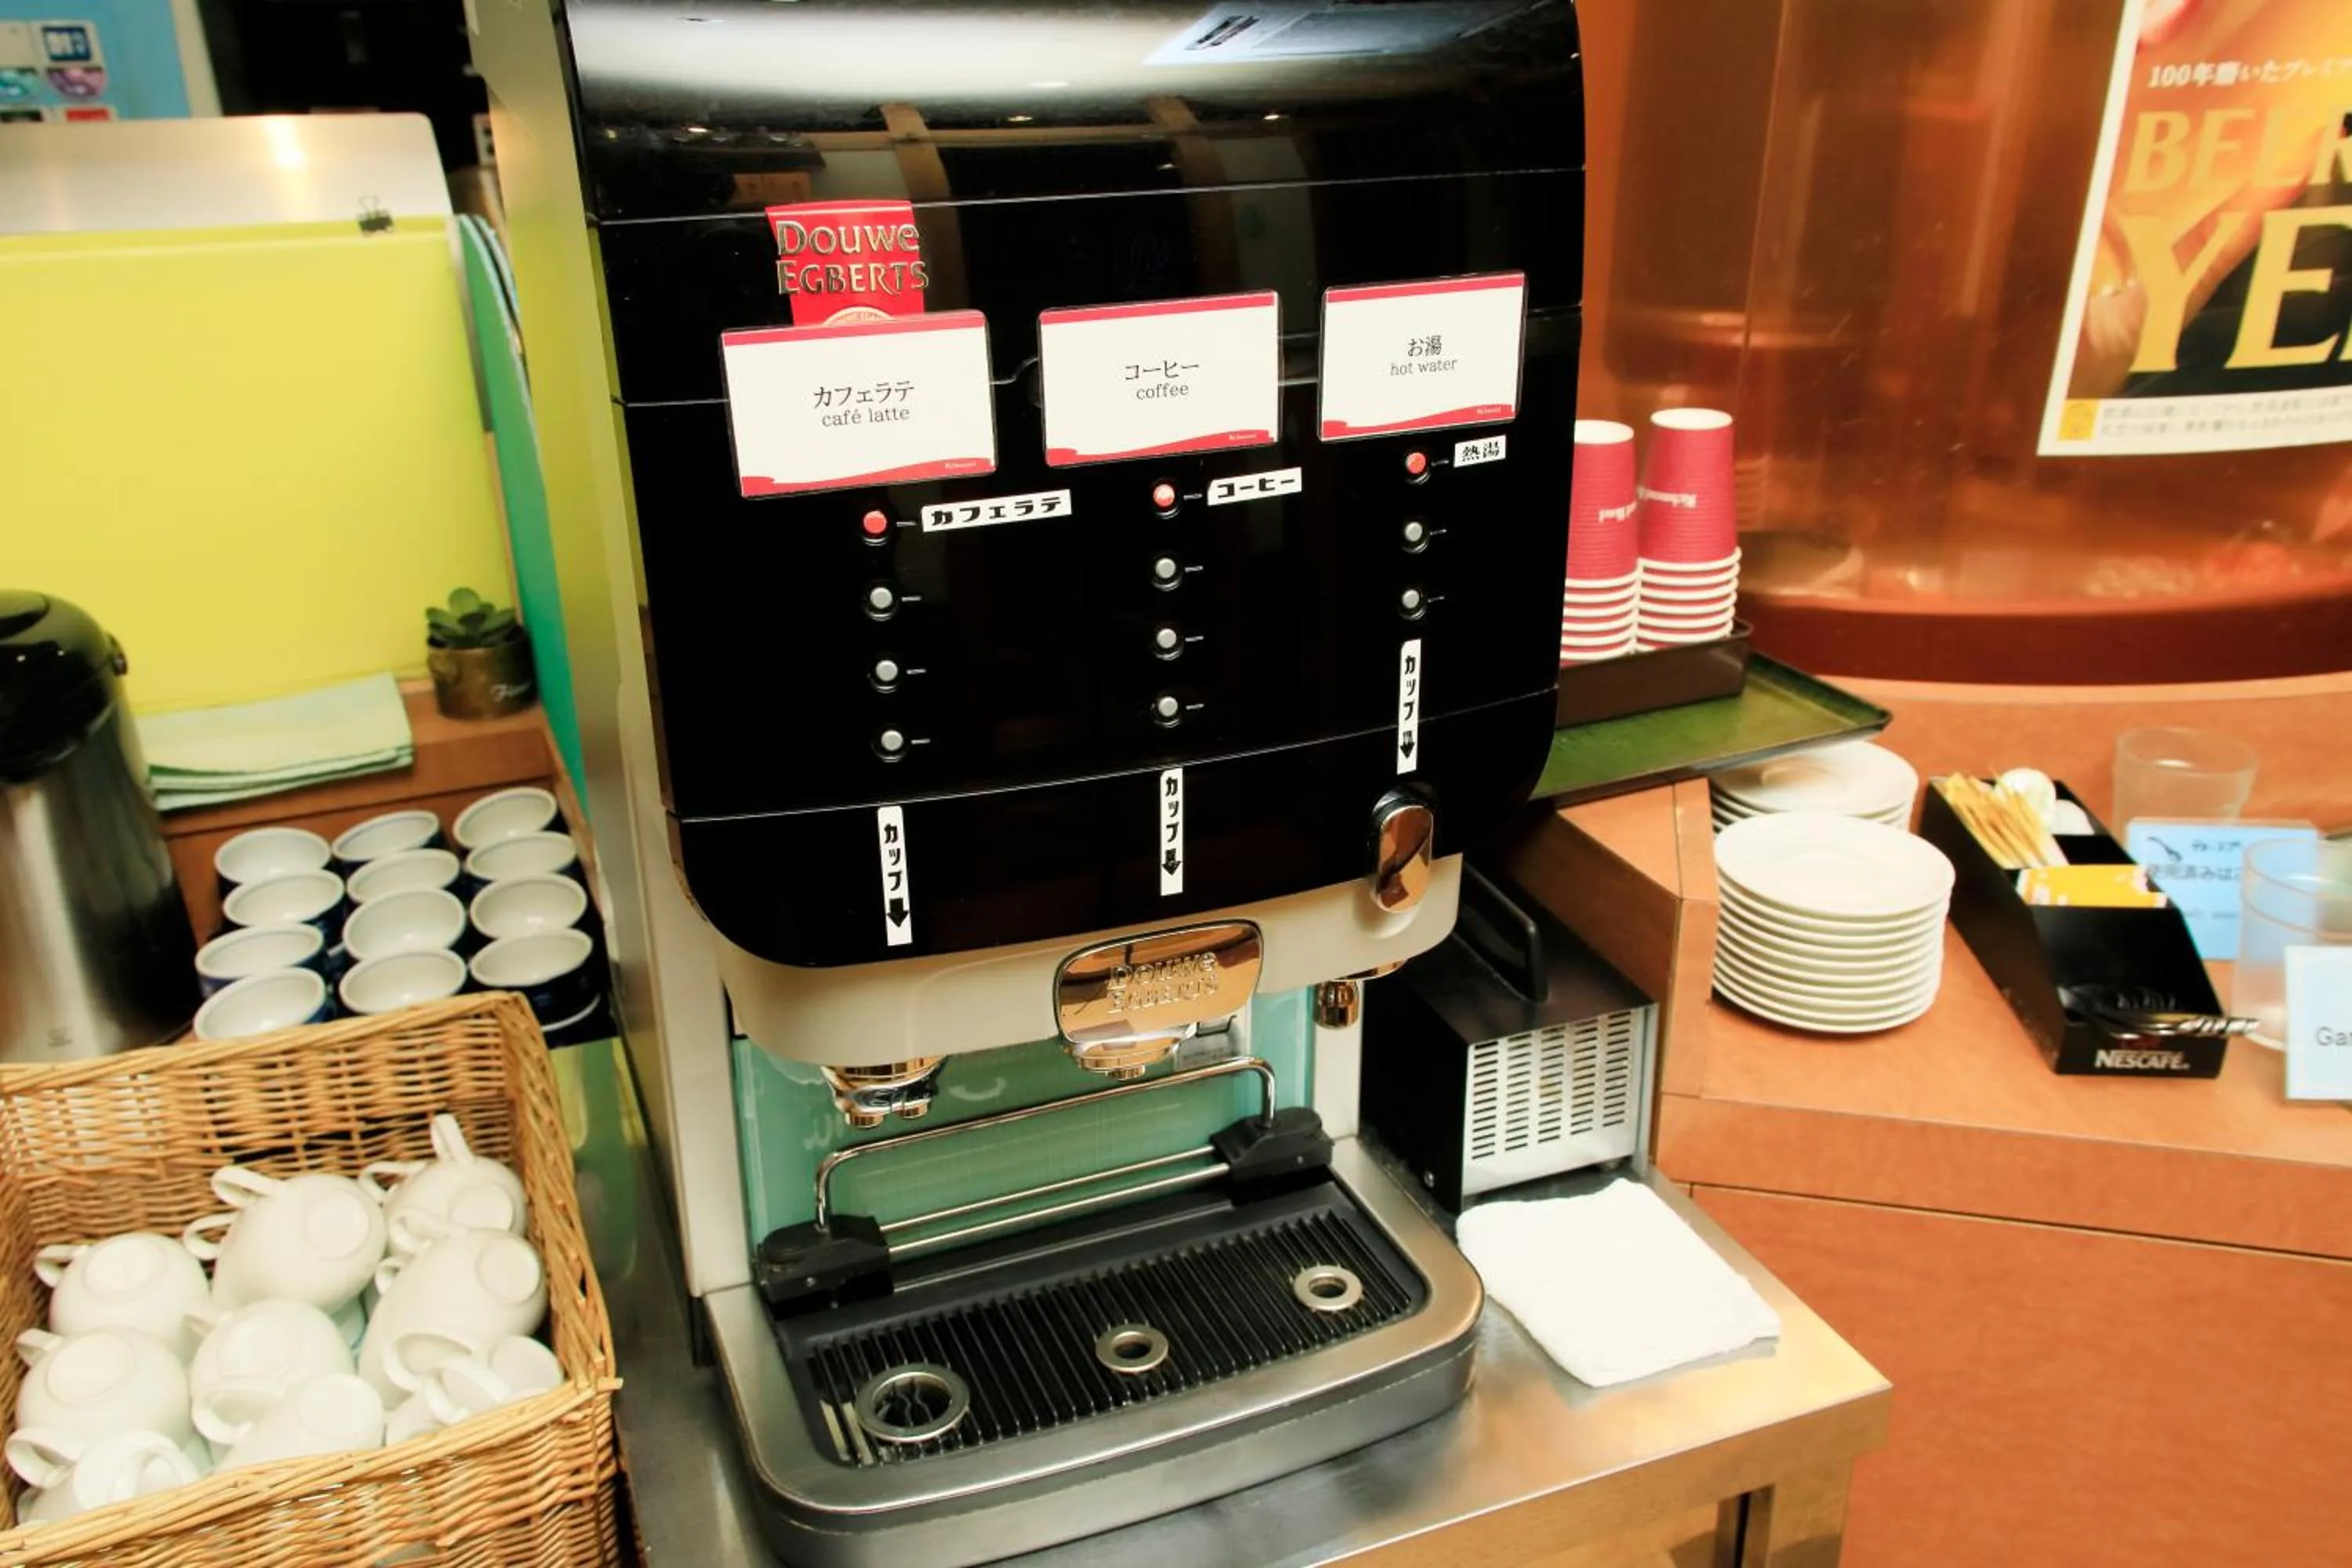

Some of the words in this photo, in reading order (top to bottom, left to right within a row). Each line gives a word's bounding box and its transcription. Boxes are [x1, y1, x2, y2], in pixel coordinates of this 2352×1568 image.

[775, 220, 920, 256] Douwe
[775, 259, 930, 296] EGBERTS
[2115, 205, 2352, 372] YE
[1407, 335, 1443, 358] お湯
[1124, 360, 1200, 381] コーヒー
[1390, 362, 1414, 377] hot
[1417, 358, 1457, 374] water
[814, 379, 915, 408] カフェラテ
[1136, 383, 1189, 401] coffee
[822, 408, 862, 427] café
[869, 406, 911, 423] latte
[1461, 441, 1500, 462] 熱湯
[1217, 477, 1296, 499] コーヒー
[931, 496, 1062, 527] カフェラテ
